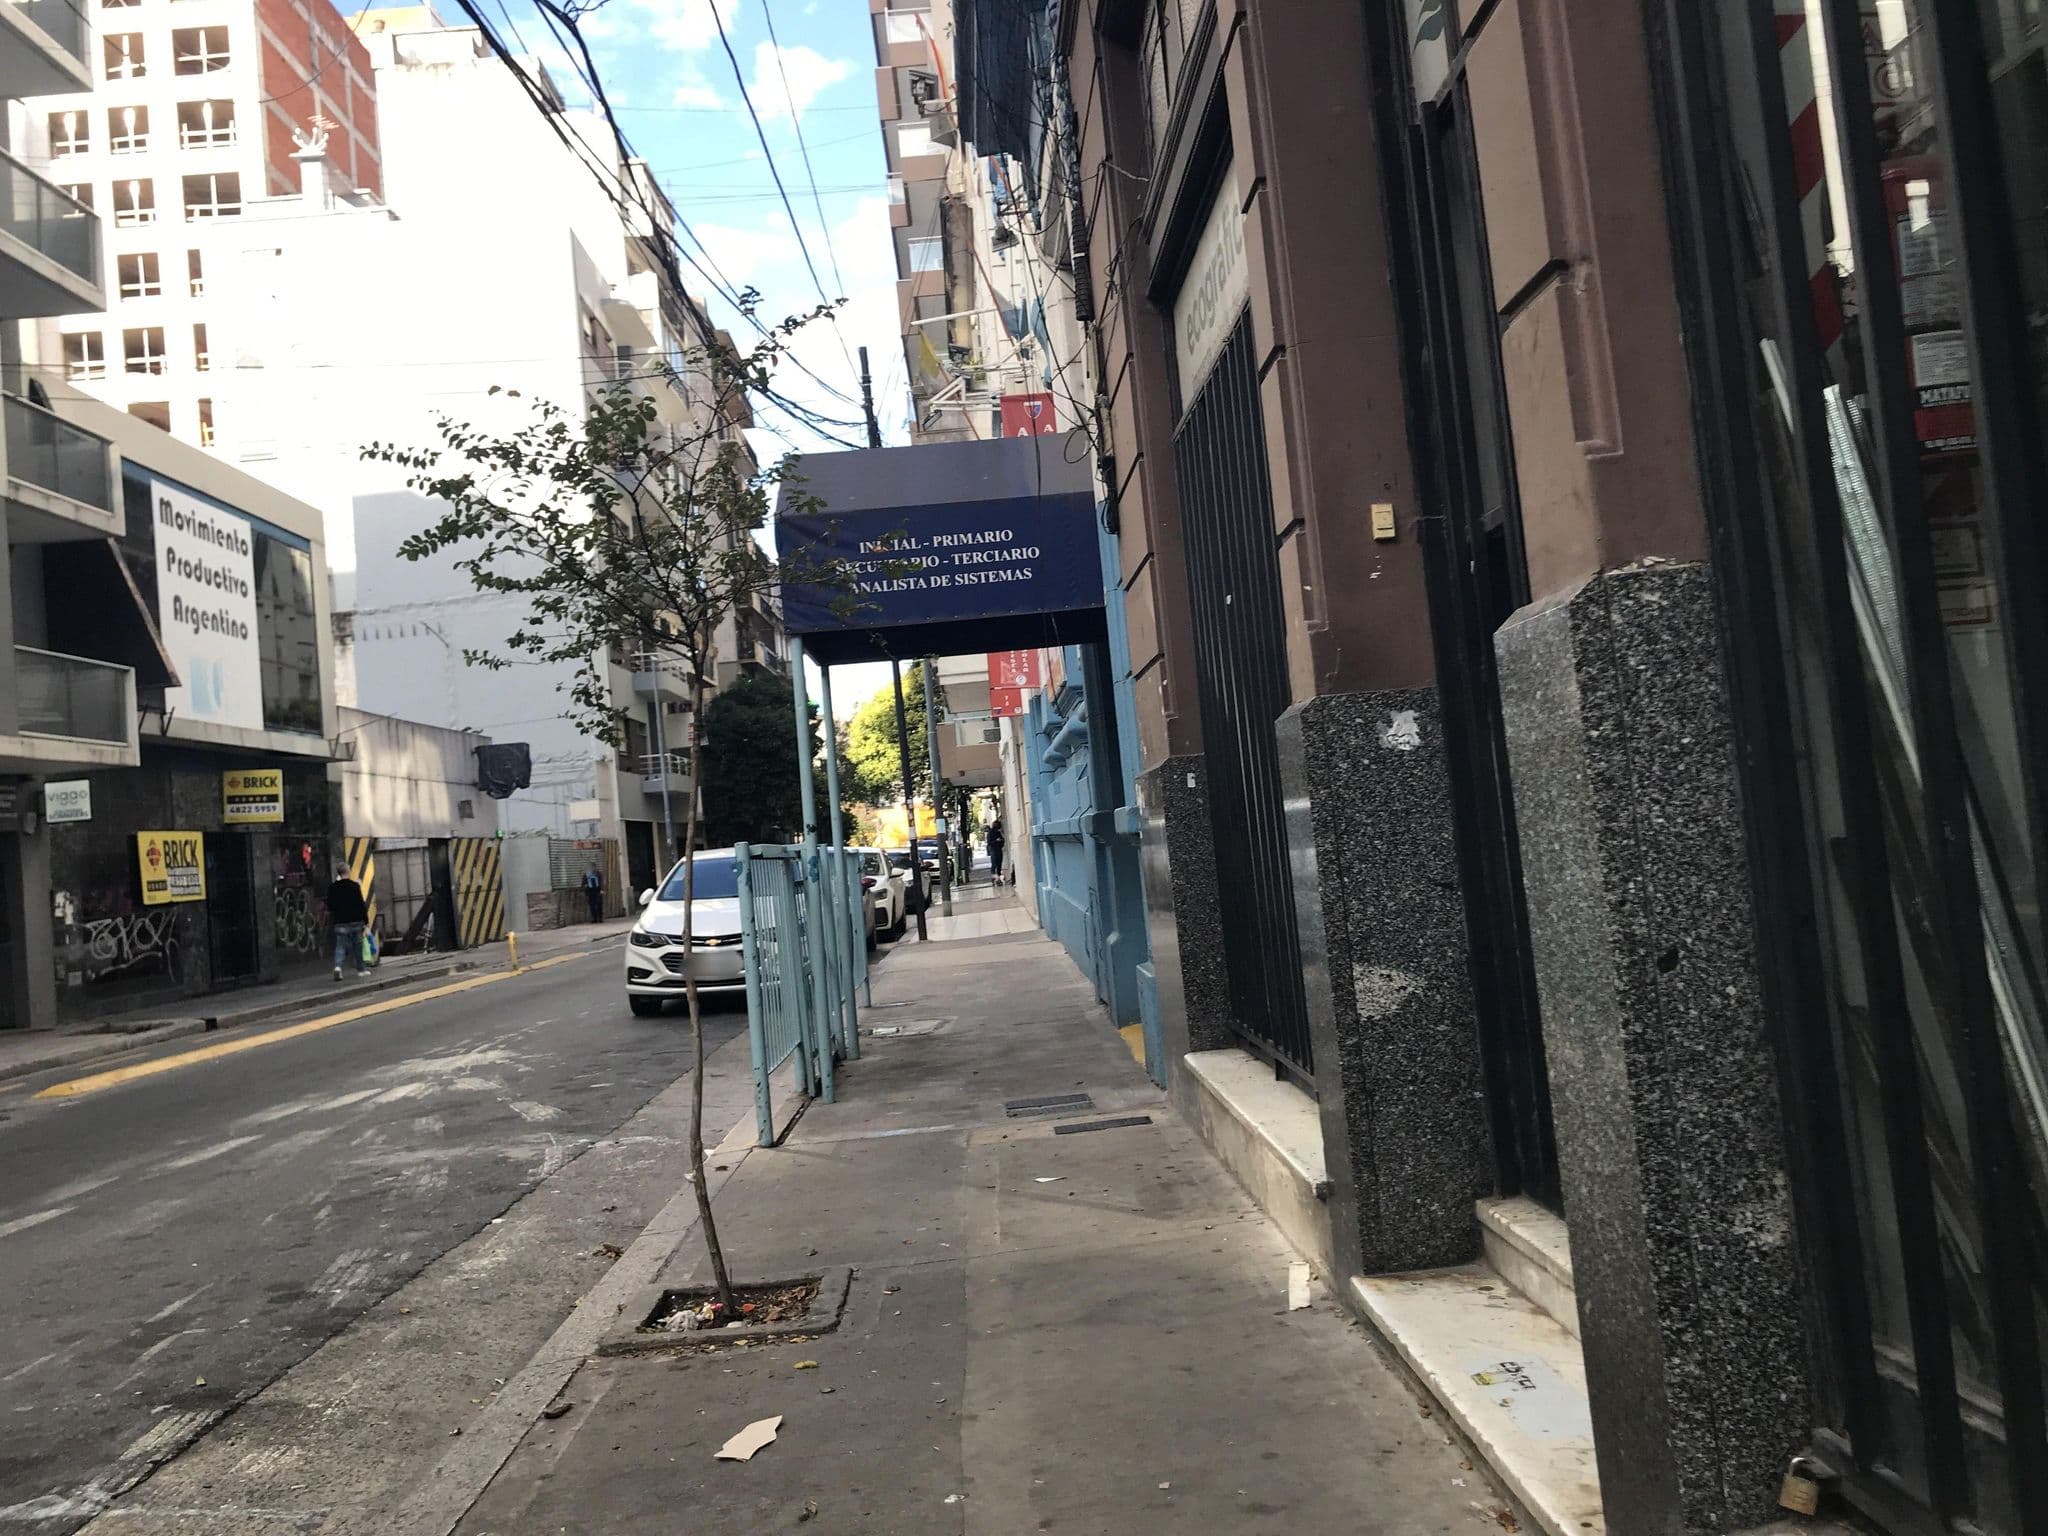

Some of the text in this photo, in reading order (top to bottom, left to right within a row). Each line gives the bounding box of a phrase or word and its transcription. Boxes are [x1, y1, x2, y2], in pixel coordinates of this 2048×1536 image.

[159, 497, 249, 557] Movimiento
[859, 537, 921, 554] INIAL
[933, 529, 1013, 548] PRIMARIO
[166, 546, 249, 598] Productivo
[836, 555, 940, 575] SECURIO
[951, 546, 1040, 565] TERCIARIO
[851, 567, 1033, 594] ANALISTA DE SISTEMAS
[173, 594, 249, 640] Argentino
[243, 775, 278, 788] BRICK
[163, 839, 199, 869] BRICK
